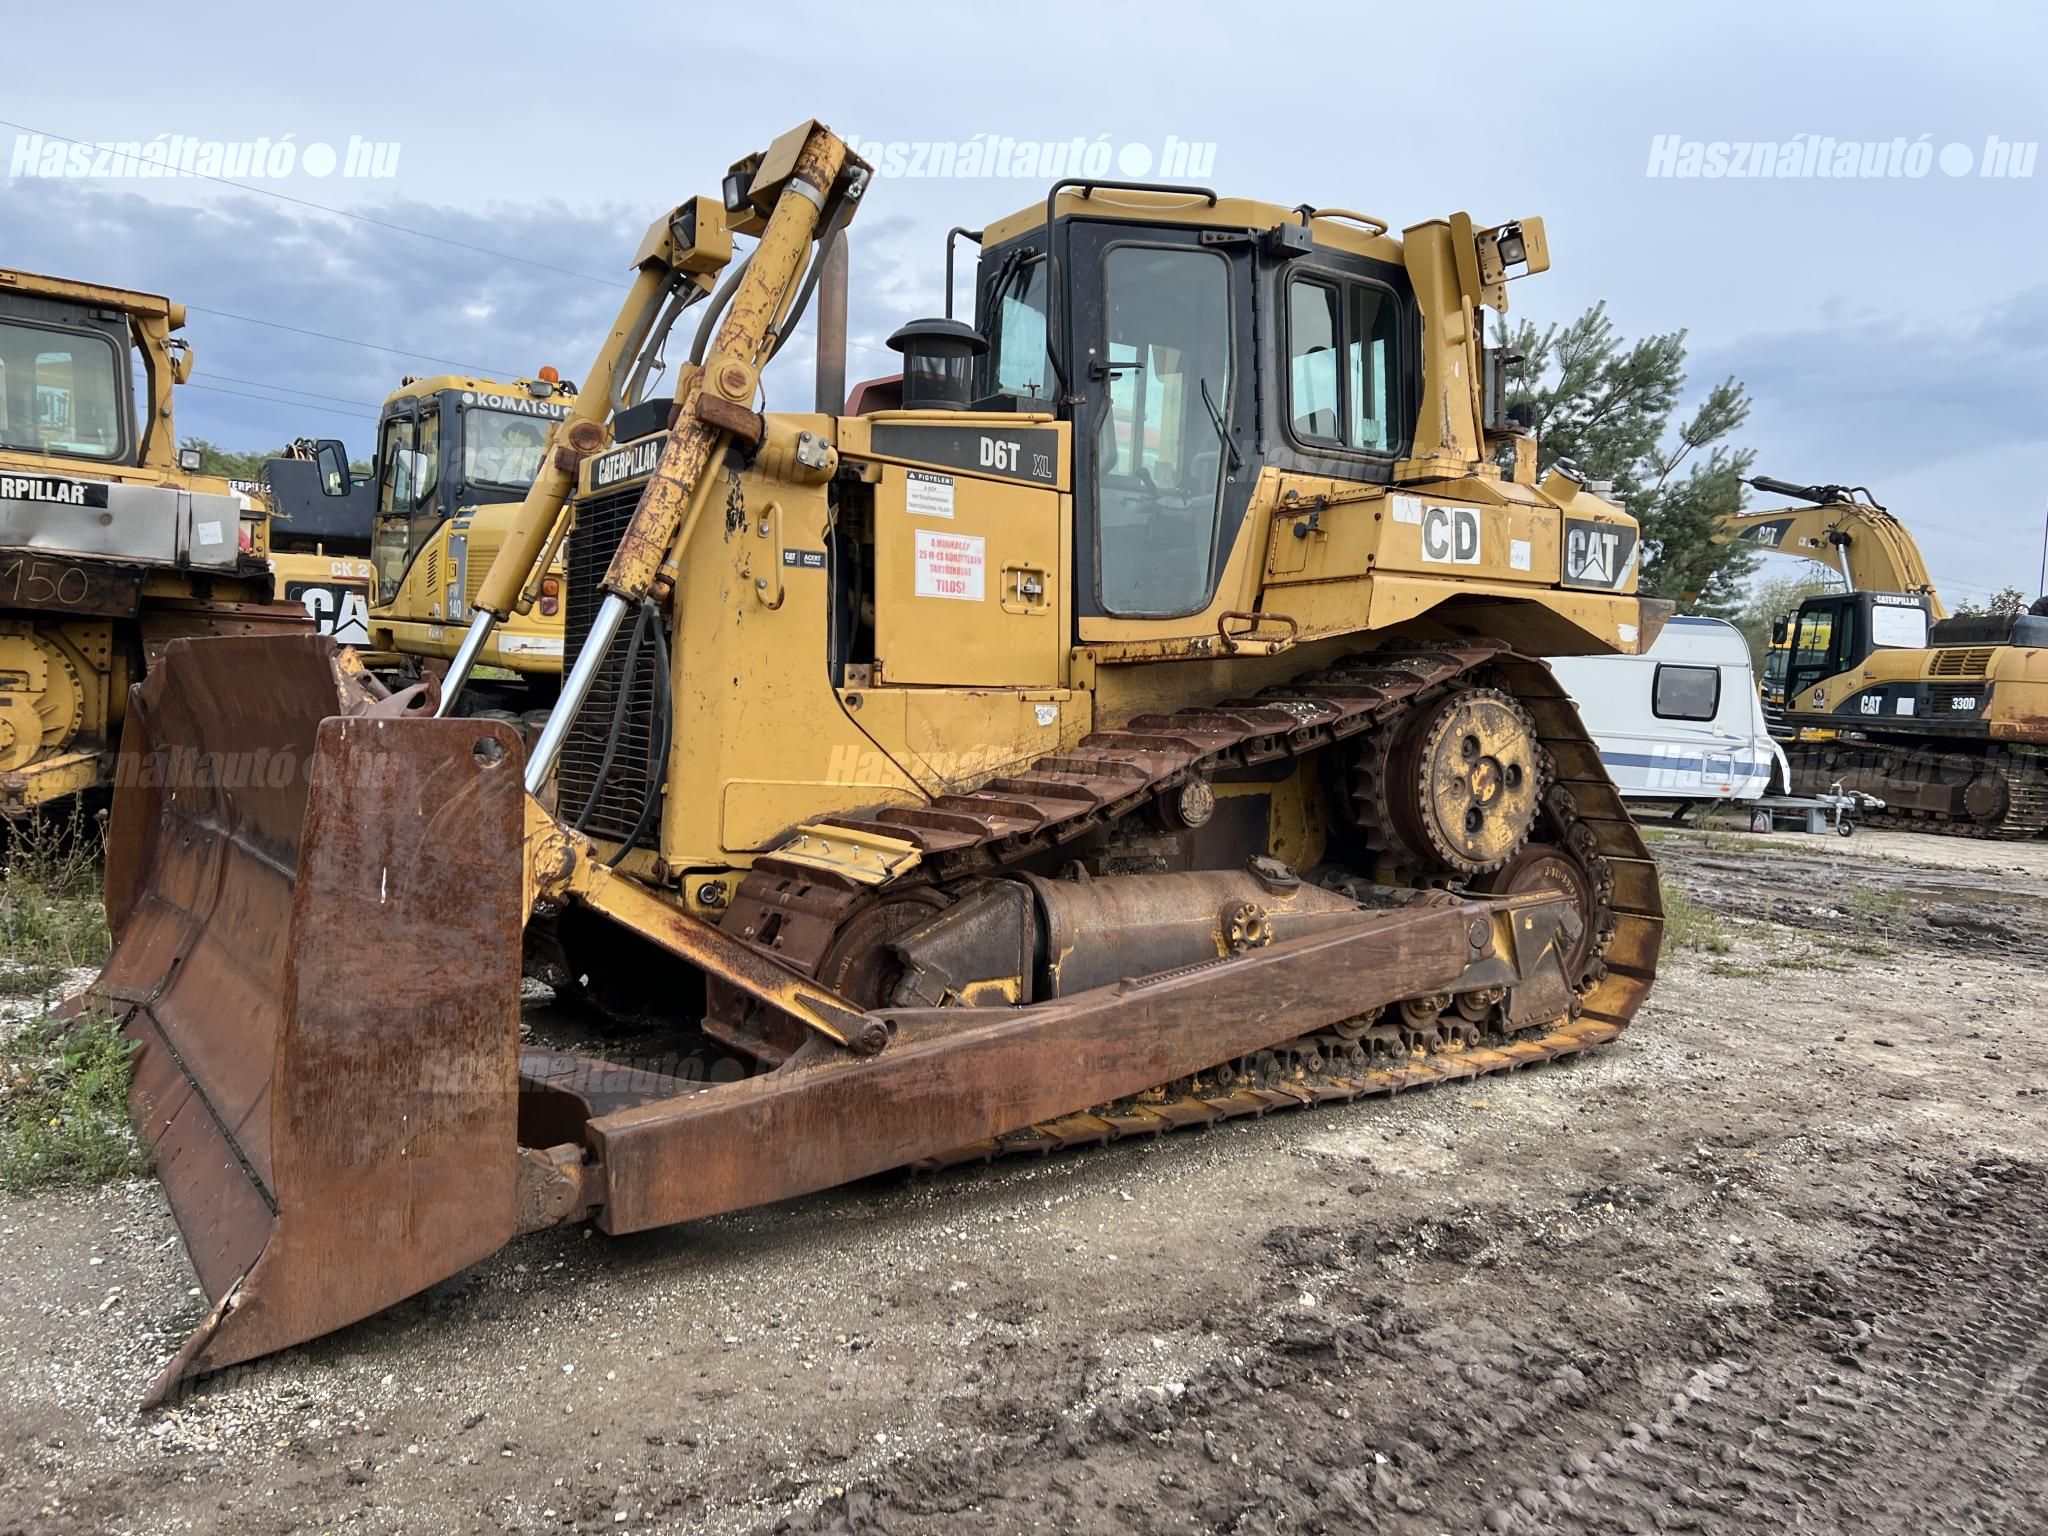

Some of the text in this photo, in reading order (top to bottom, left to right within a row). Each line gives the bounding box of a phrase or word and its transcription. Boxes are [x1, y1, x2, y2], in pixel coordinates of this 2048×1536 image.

[476, 392, 561, 418] KOMATSU
[598, 441, 659, 485] CATERPILLAR
[979, 436, 1052, 478] D6T XL
[1757, 525, 1778, 548] CAT
[1567, 528, 1619, 583] CAT
[4, 559, 89, 604] 150
[449, 599, 462, 618] 140
[1876, 595, 1920, 606] CATERPILLAR
[1860, 695, 1883, 714] CAT
[1951, 697, 1976, 710] 330D
